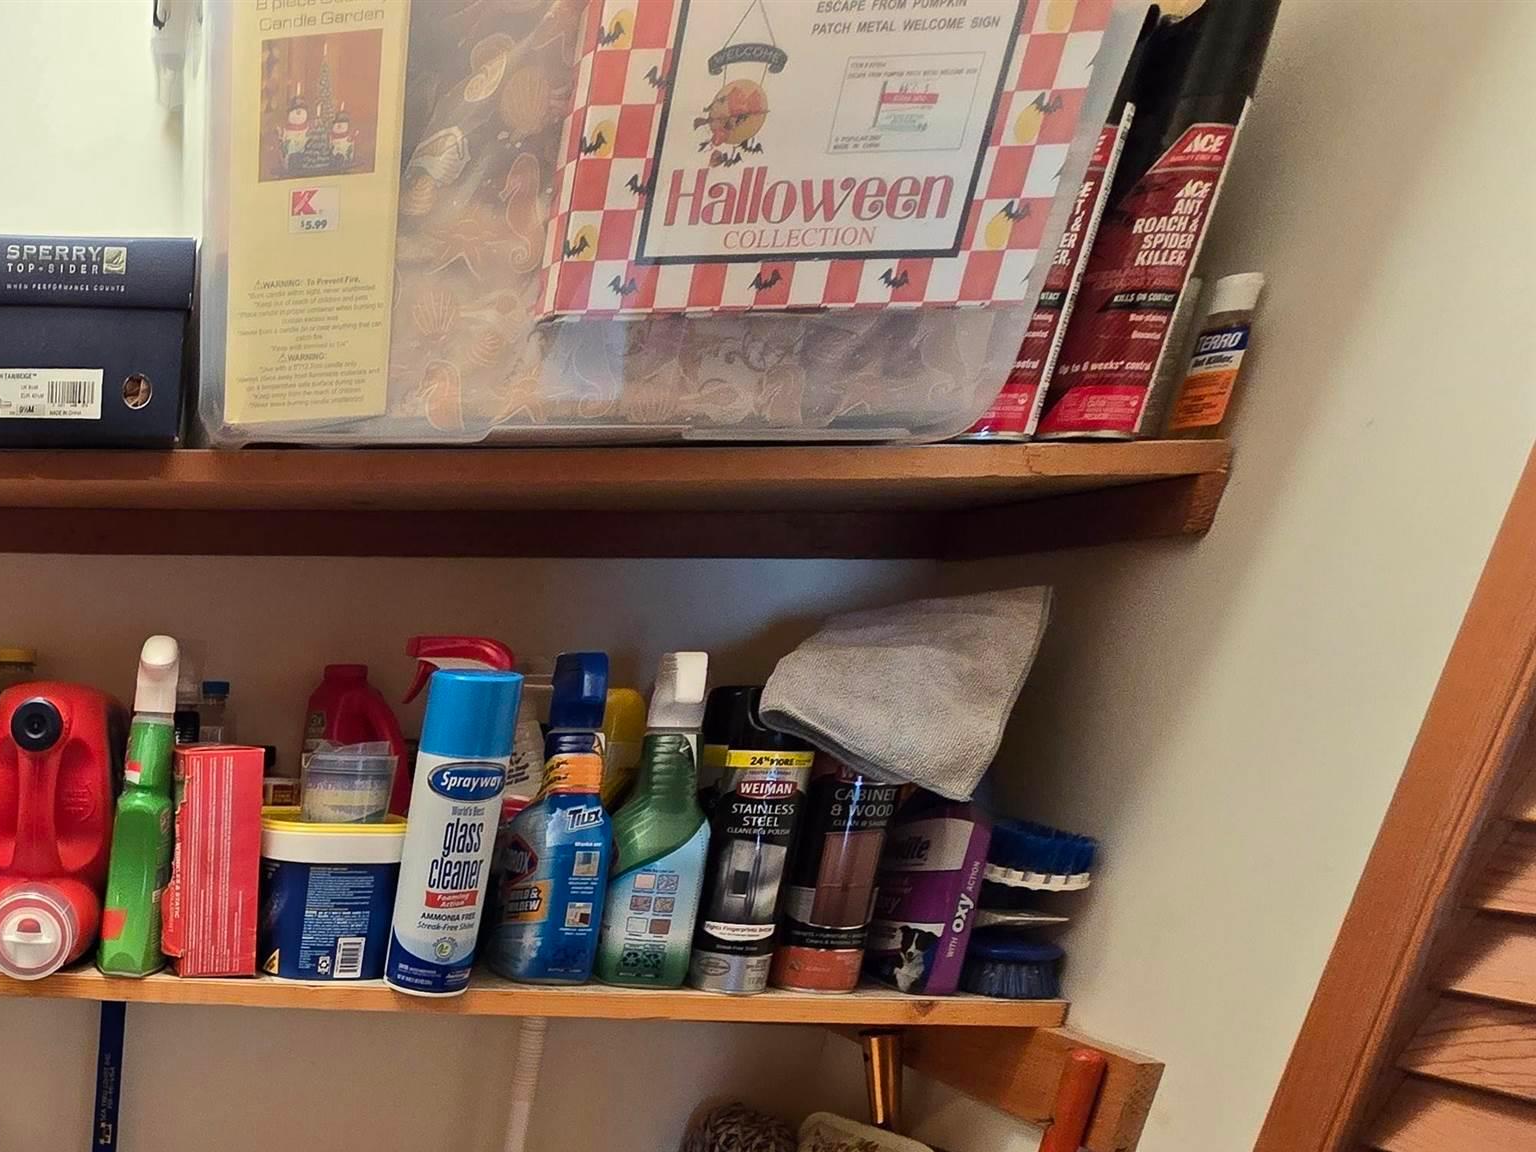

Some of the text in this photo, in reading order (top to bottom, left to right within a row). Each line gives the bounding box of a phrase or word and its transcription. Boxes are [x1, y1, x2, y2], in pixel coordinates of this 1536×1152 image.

[816, 0, 865, 13] ESCAPE
[871, 0, 907, 10] FROM
[259, 9, 385, 32] Candle Garden
[811, 15, 1001, 36] PATCH METAL WELCOME SIGN
[713, 46, 781, 64] WELCOME
[1182, 132, 1228, 154] ACE
[664, 166, 954, 227] Halloween
[1173, 179, 1213, 199] ACE
[1172, 198, 1204, 218] ANT,
[300, 219, 328, 230] $5.99
[1132, 216, 1188, 234] ROACH
[723, 226, 876, 250] COLLECTION
[1140, 233, 1195, 250] SPIDER
[6, 244, 101, 262] SPERRY
[1114, 293, 1134, 302] KILLS
[1196, 332, 1242, 354] TERRO
[440, 771, 503, 792] Sprayway
[740, 782, 794, 794] WEIMAN
[834, 788, 898, 802] CABINET
[731, 802, 795, 815] STAINLESS
[830, 804, 894, 816] & WOOD
[742, 815, 780, 827] STEEL
[442, 817, 484, 858] glass
[428, 858, 484, 890] cleaner
[421, 912, 476, 921] AMMONIA FREE
[946, 860, 980, 958] WITH oxy ACTION
[416, 921, 458, 931] Streak-Free
